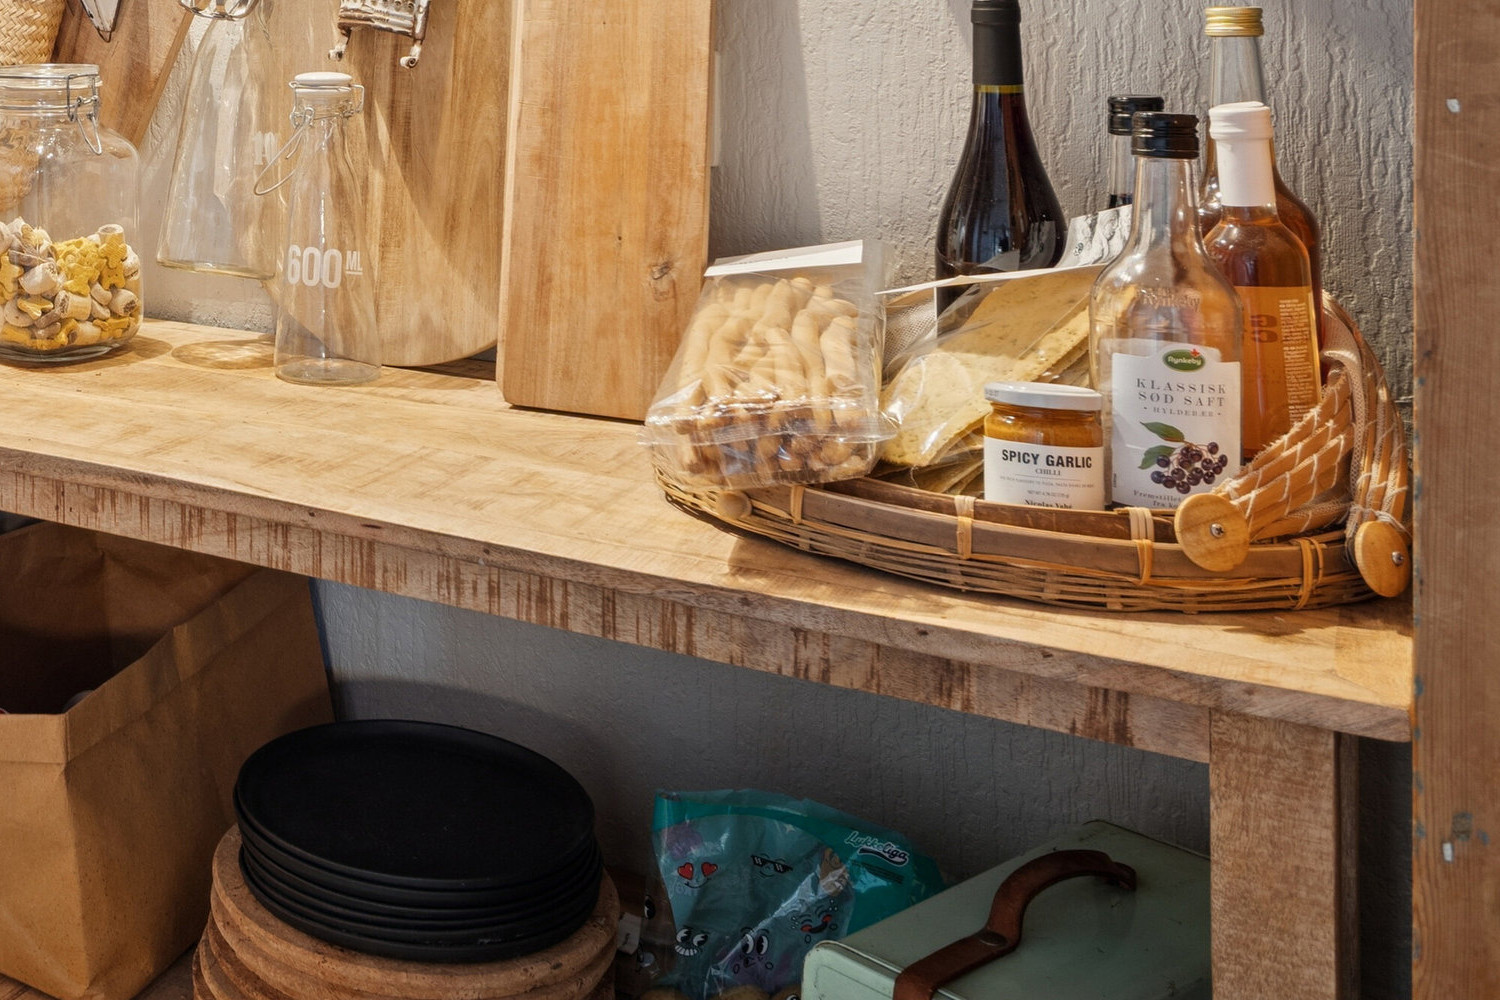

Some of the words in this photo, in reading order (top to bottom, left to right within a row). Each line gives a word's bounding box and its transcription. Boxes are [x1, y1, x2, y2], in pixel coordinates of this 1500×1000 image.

[287, 245, 343, 288] 600
[345, 250, 363, 275] ML
[1167, 355, 1202, 366] Rynkeby
[1136, 378, 1227, 394] KLASSISK
[1138, 391, 1174, 404] SØD
[1184, 396, 1226, 408] SAFT
[1002, 449, 1040, 466] SPICY
[1046, 454, 1092, 469] GARLIC
